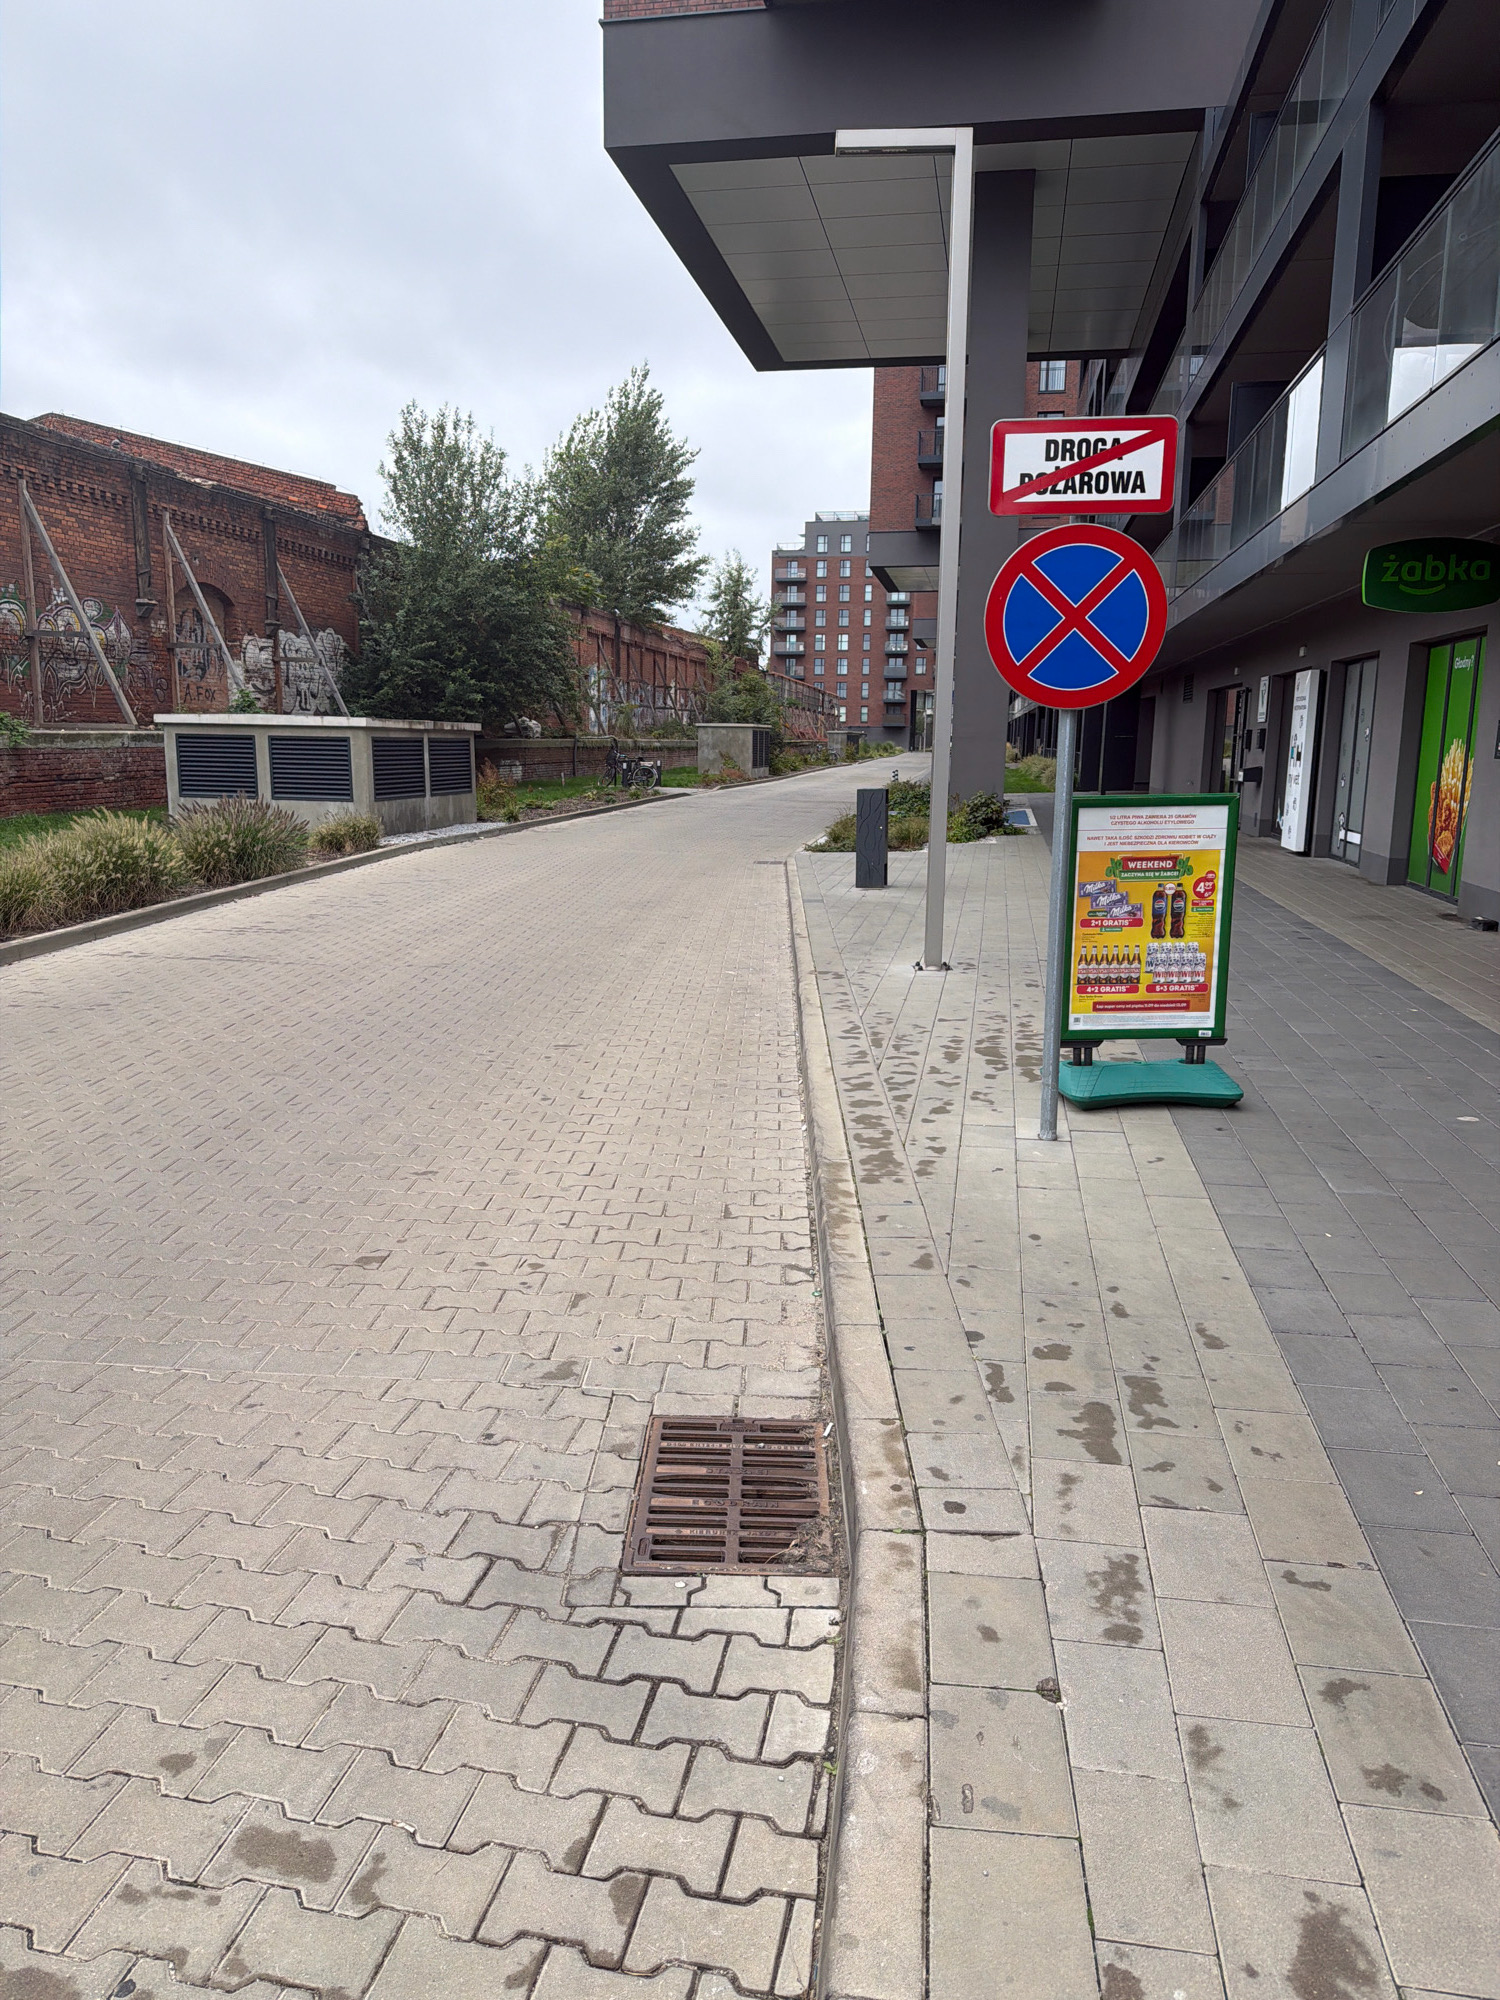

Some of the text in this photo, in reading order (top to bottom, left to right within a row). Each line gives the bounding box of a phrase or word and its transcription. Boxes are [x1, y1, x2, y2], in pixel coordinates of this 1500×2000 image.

[1044, 438, 1123, 462] DROGA
[1019, 466, 1146, 495] POŻAROWA
[1381, 554, 1491, 582] żabka
[1128, 860, 1173, 869] WEEKEND
[1084, 882, 1106, 894] Milka
[1096, 893, 1121, 906] Milka
[1110, 905, 1132, 917] Milka
